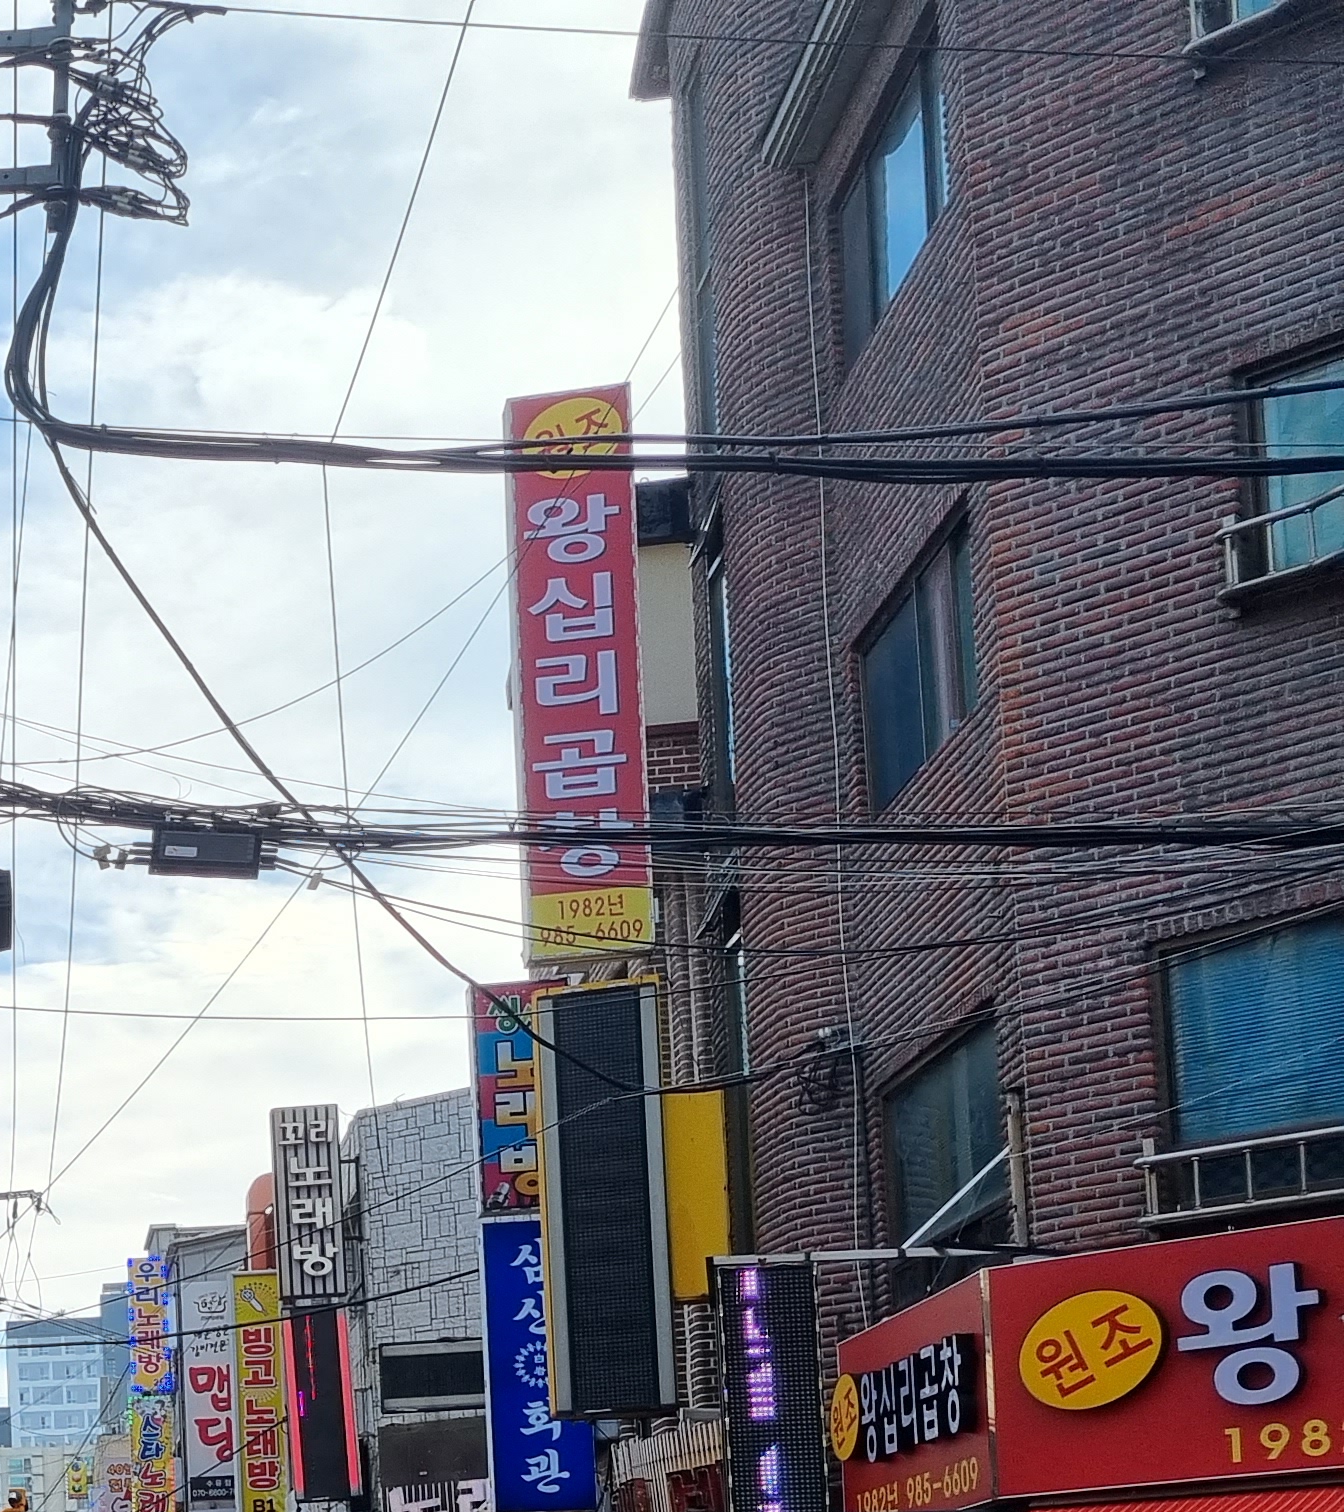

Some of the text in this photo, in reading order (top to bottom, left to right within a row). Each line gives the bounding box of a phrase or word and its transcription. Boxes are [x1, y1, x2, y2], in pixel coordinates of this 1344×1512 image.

[523, 492, 635, 879] 왕십리곱창
[539, 919, 644, 949] 985-6609
[557, 894, 625, 921] 1982년
[288, 1157, 340, 1277] 노래방
[135, 1262, 161, 1306] 우리
[137, 1308, 162, 1374] 노래방
[241, 1326, 275, 1387] 빙고
[1034, 1302, 1154, 1400] 원조
[831, 1384, 858, 1449] 원조
[860, 1333, 963, 1464] 왕십리곱창
[140, 1414, 165, 1461] 스타
[244, 1398, 282, 1491] 노래방
[1223, 1418, 1344, 1464] 198
[906, 1456, 980, 1508] 985-6609
